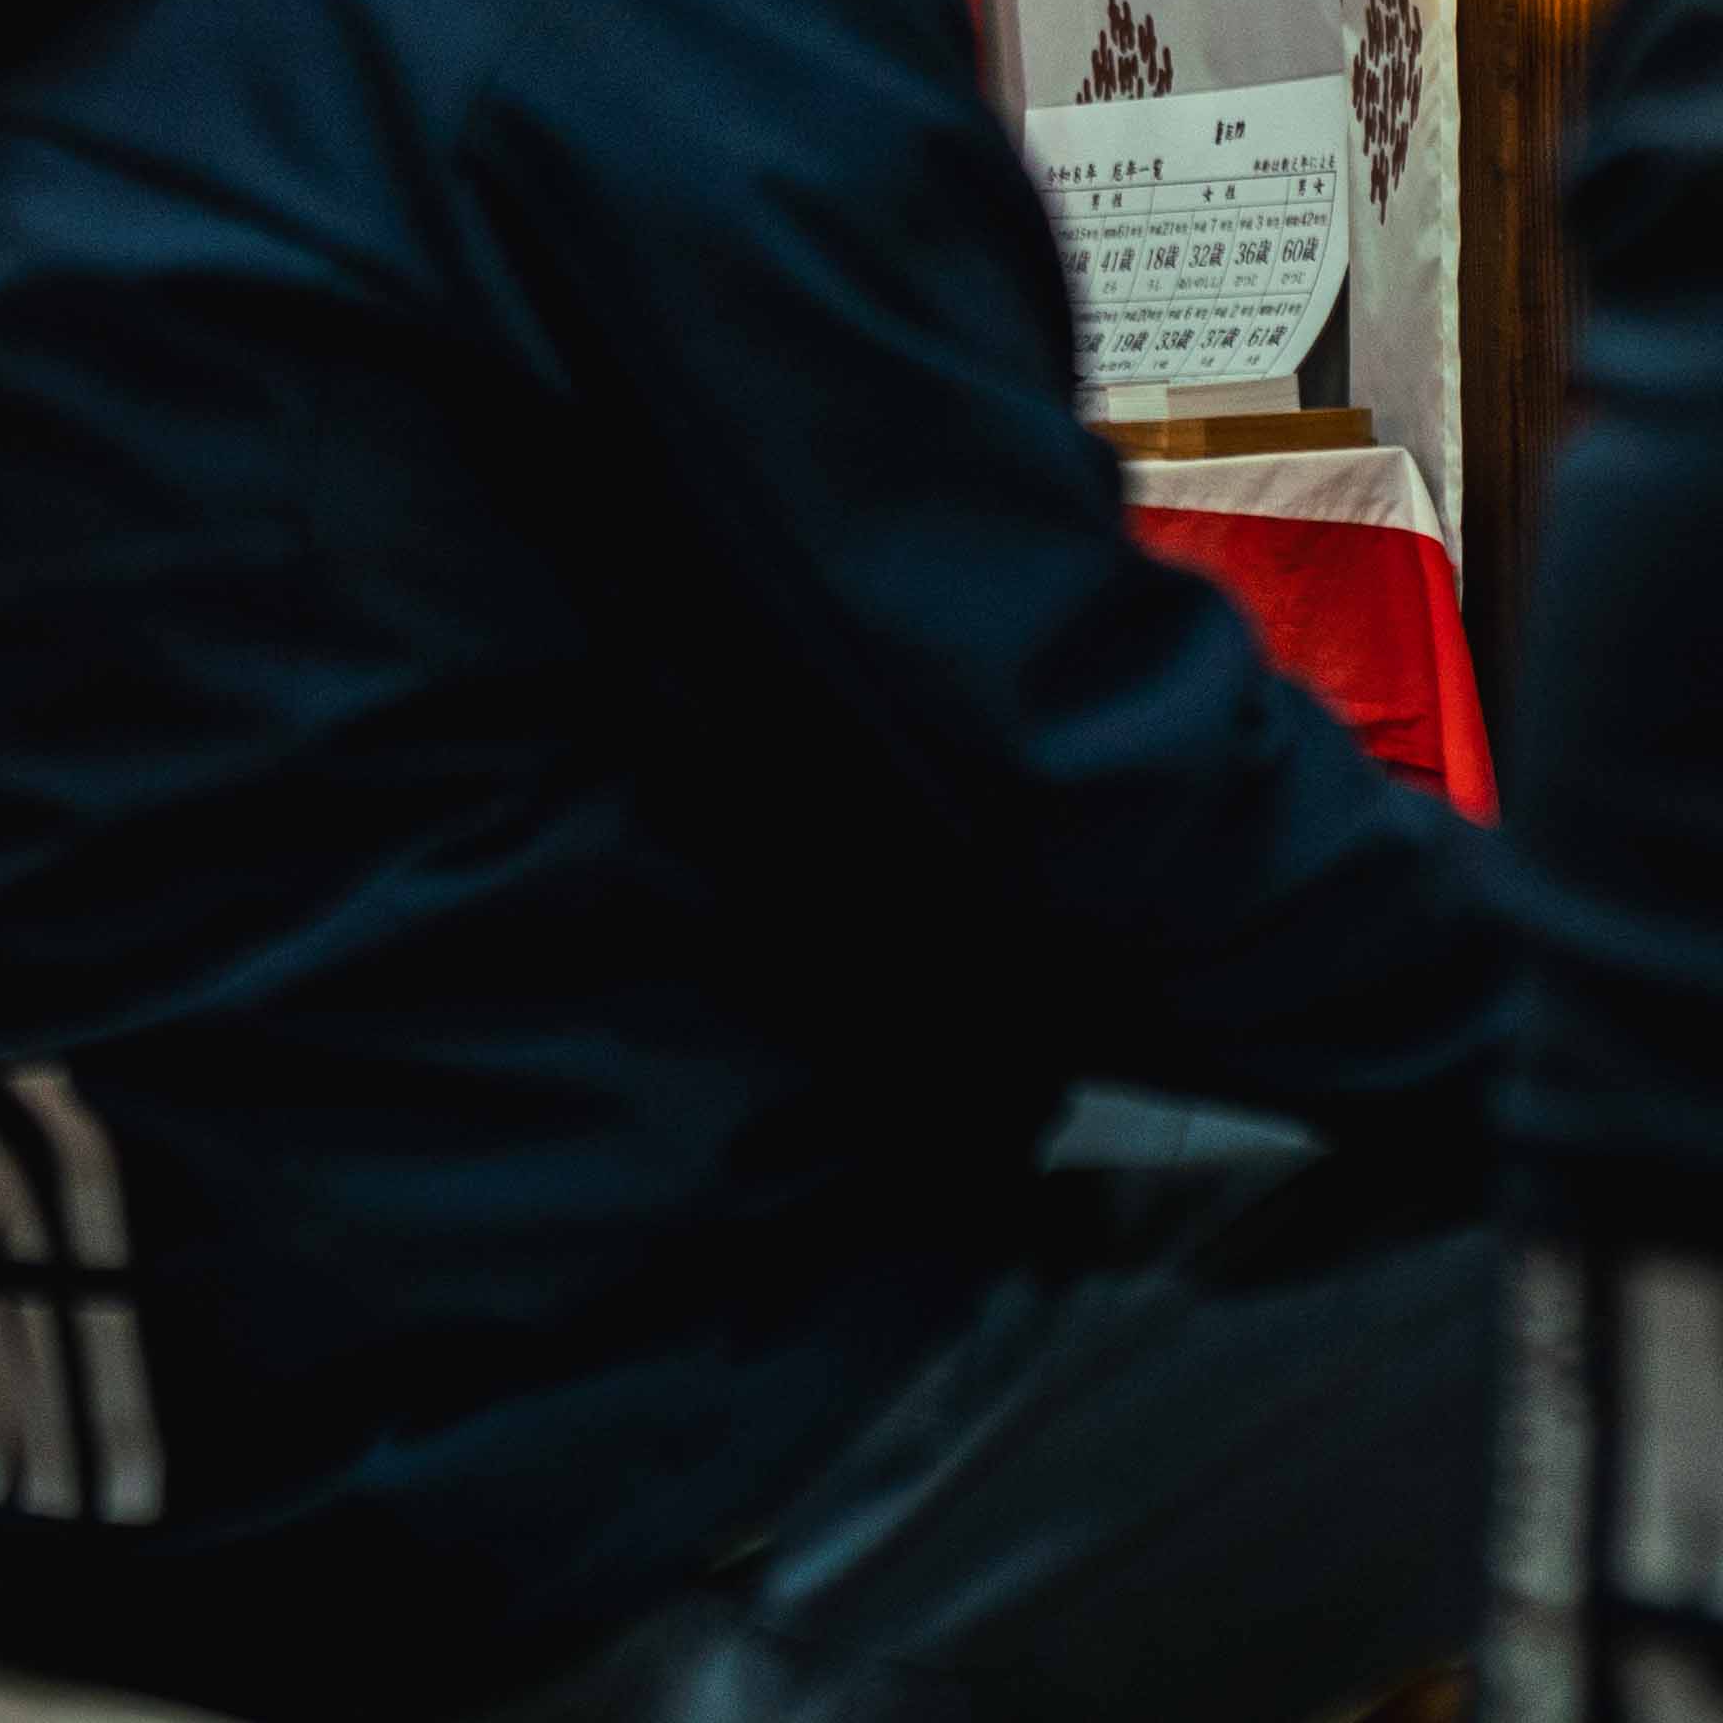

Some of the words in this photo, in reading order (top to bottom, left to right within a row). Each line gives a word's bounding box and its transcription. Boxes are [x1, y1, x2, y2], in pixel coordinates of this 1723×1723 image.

[1100, 246, 1135, 272] 41歳
[1145, 243, 1180, 271] 18歳
[1188, 241, 1226, 268] 32歳
[1234, 238, 1272, 265] 36歳
[1282, 236, 1320, 263] 60歳
[1155, 329, 1195, 351] 33歳
[1200, 327, 1241, 349] 37歳
[1247, 325, 1288, 348] 61歳
